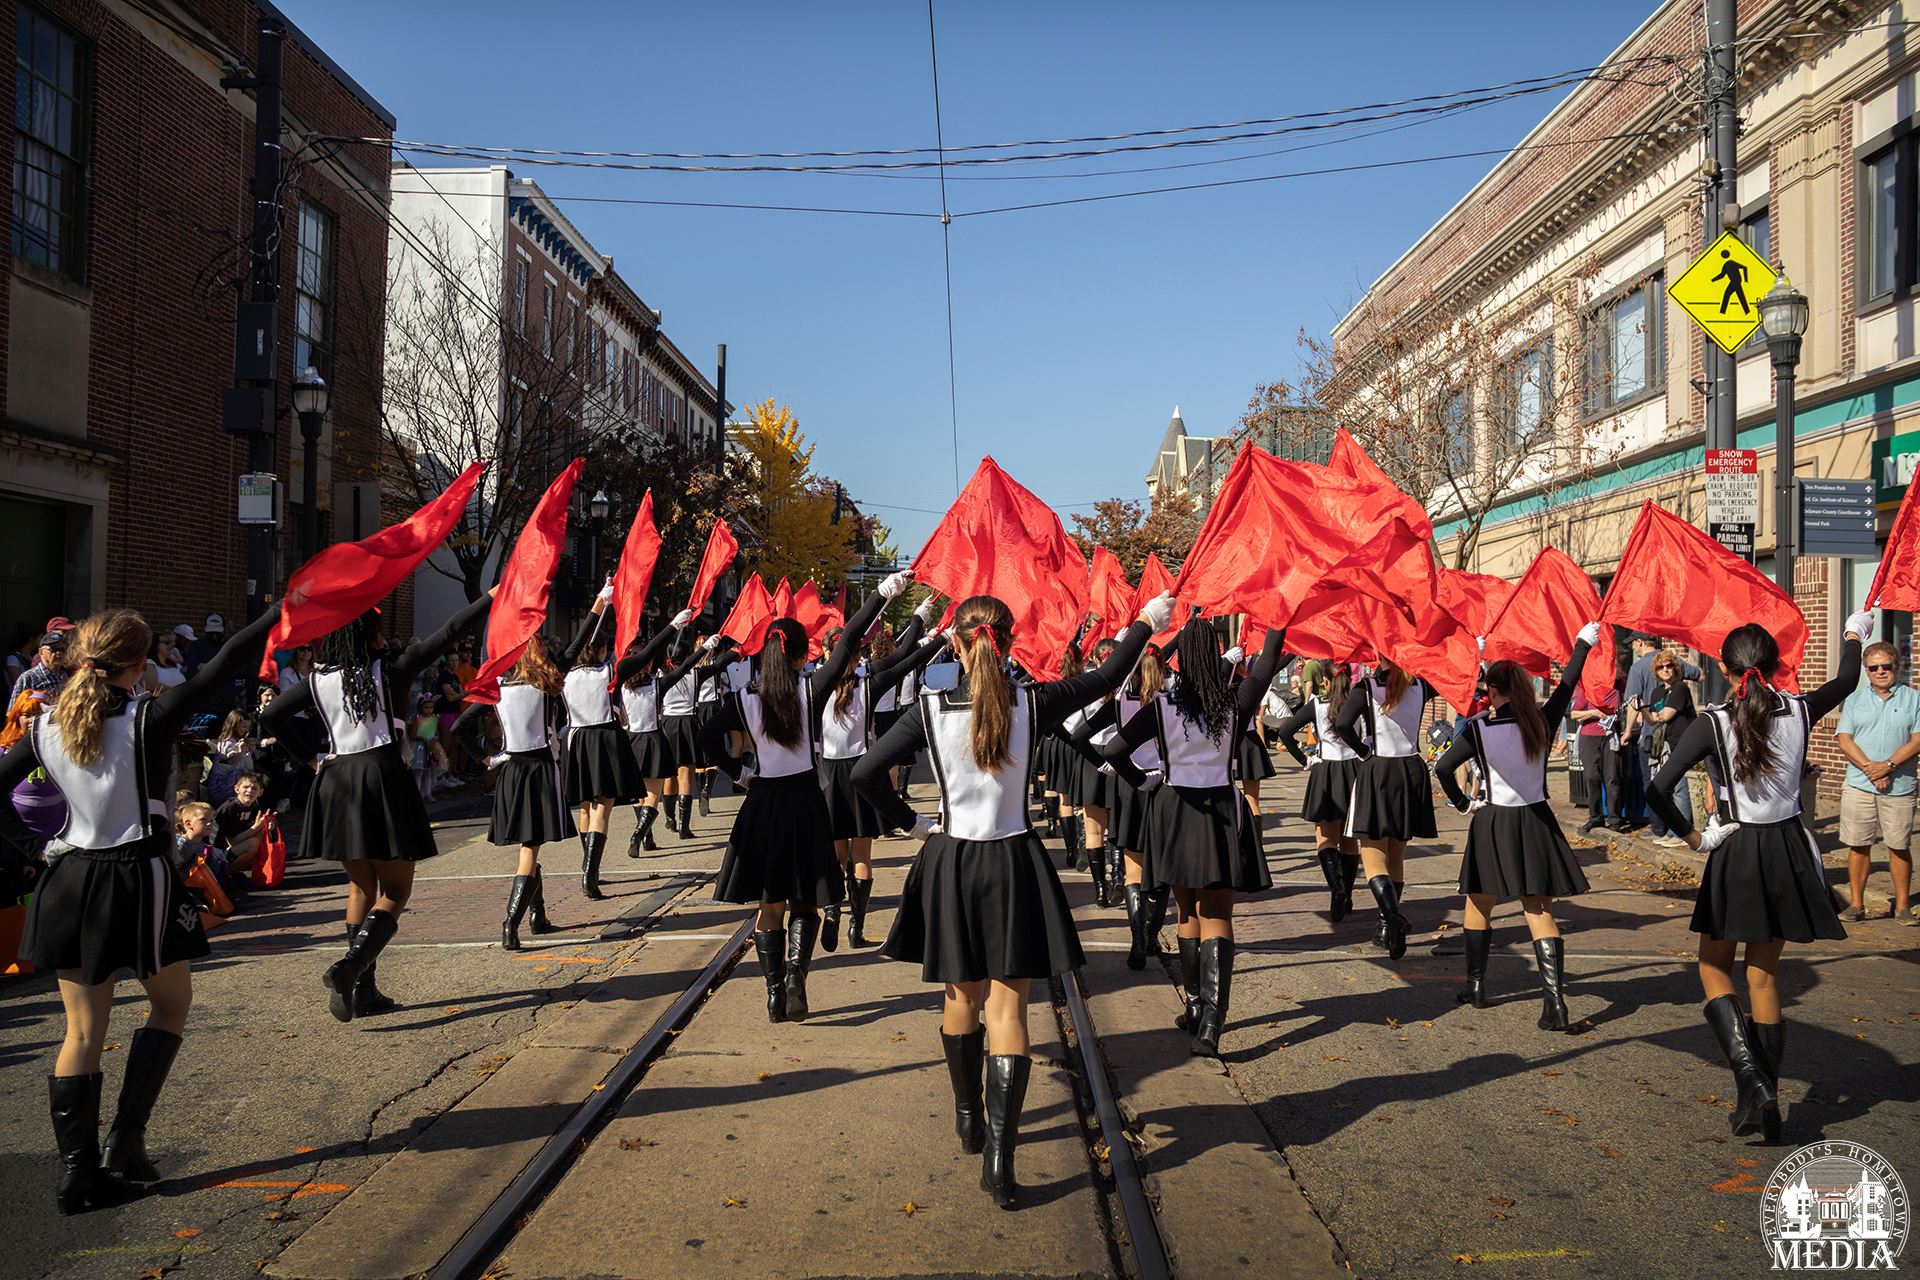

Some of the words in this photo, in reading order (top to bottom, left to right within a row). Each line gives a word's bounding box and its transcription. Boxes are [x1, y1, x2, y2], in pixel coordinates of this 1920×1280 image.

[1534, 233, 1578, 279] TRUST
[1585, 159, 1679, 243] COMPANY
[1719, 450, 1743, 458] SNOW
[1719, 466, 1743, 474] ROUTE
[1881, 450, 1920, 489] M&
[1708, 474, 1725, 482] SNOW
[1746, 474, 1755, 482] OR
[1707, 482, 1727, 490] CHAINS
[1729, 482, 1758, 490] REQUIRED
[241, 486, 254, 496] 101
[1712, 490, 1721, 498] NO
[1724, 490, 1752, 498] PARKING
[1721, 507, 1745, 515] VEHICLES
[1822, 508, 1837, 516] County
[1720, 523, 1740, 532] ZONE
[1716, 532, 1748, 543] PARKING
[1735, 544, 1752, 553] LIMIT
